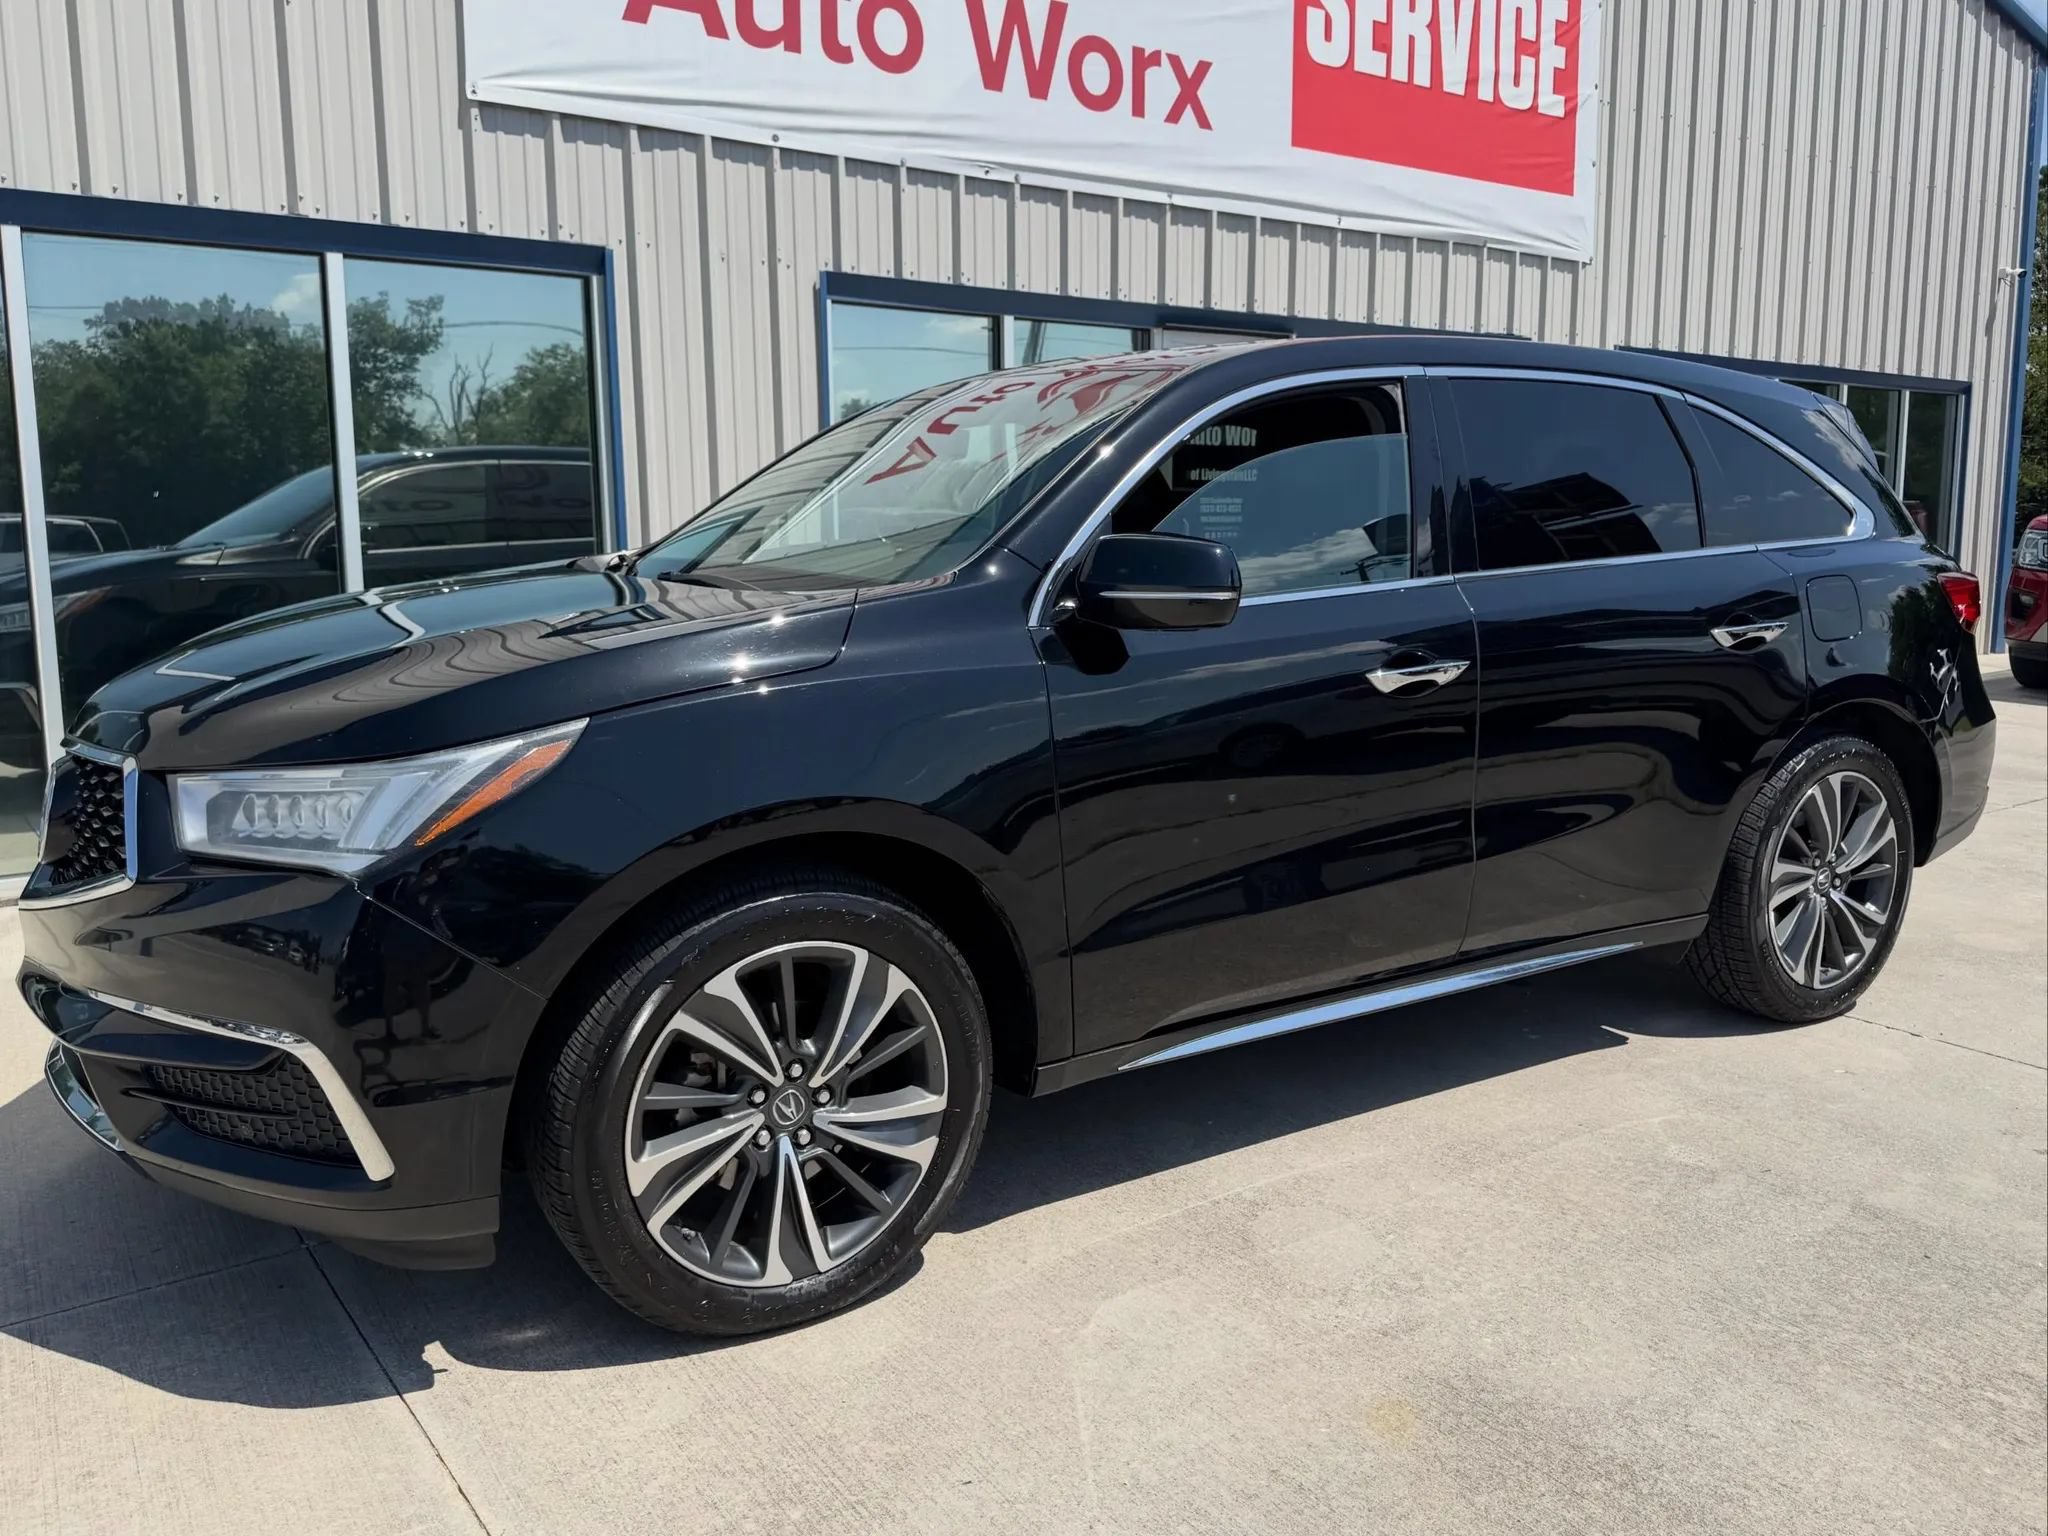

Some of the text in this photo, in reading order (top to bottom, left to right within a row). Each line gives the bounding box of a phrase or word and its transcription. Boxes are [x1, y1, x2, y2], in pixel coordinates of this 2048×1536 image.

[622, 0, 1213, 131] uto Worx
[1305, 0, 1568, 118] SERVICE
[1189, 425, 1257, 447] uto Wor
